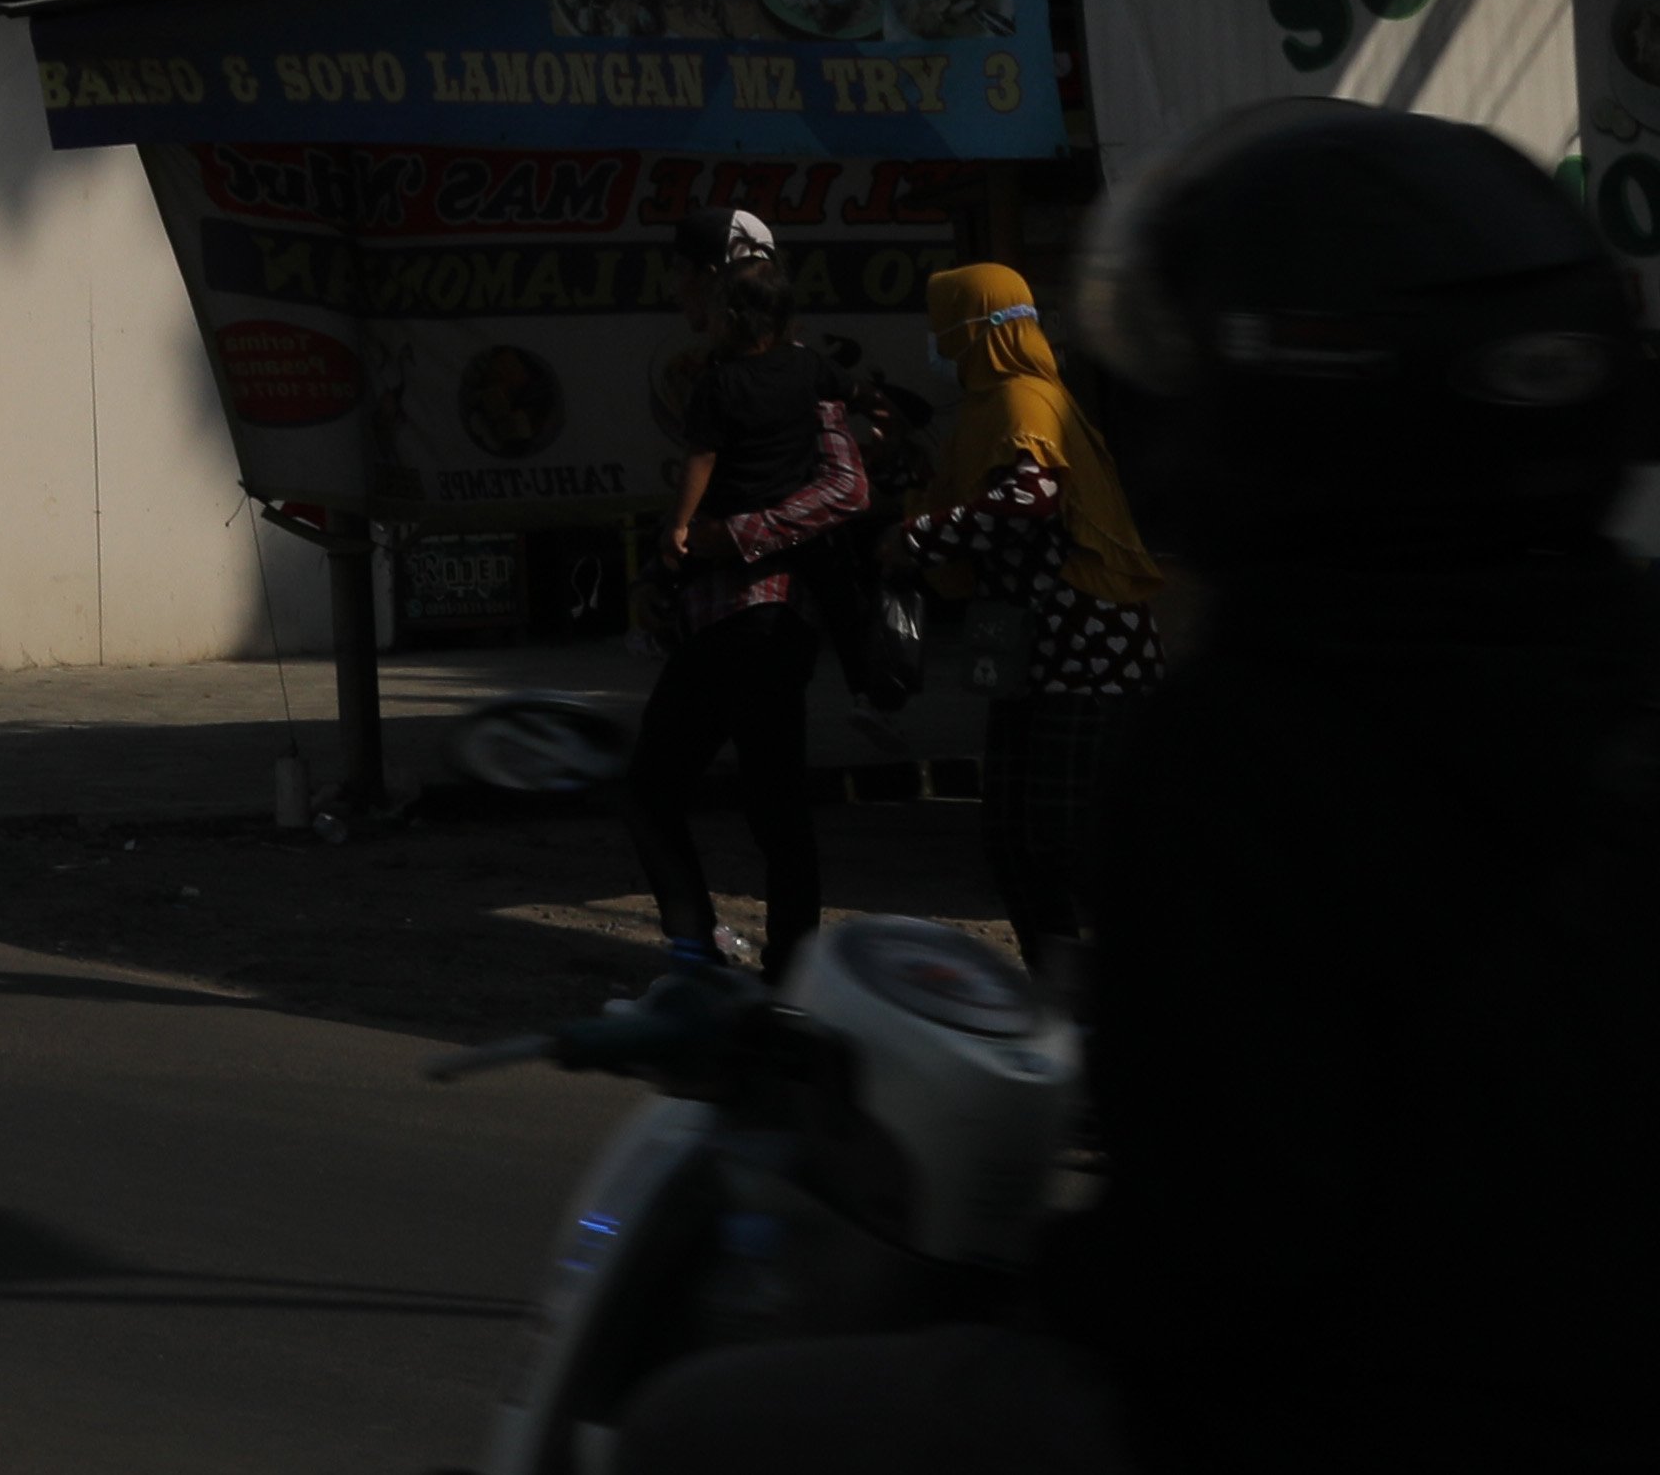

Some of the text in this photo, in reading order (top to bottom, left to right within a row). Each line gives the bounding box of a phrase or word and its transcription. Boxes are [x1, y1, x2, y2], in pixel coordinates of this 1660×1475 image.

[38, 50, 1021, 114] BAKSO & SOTO LAMONGAN MZ TRY 3
